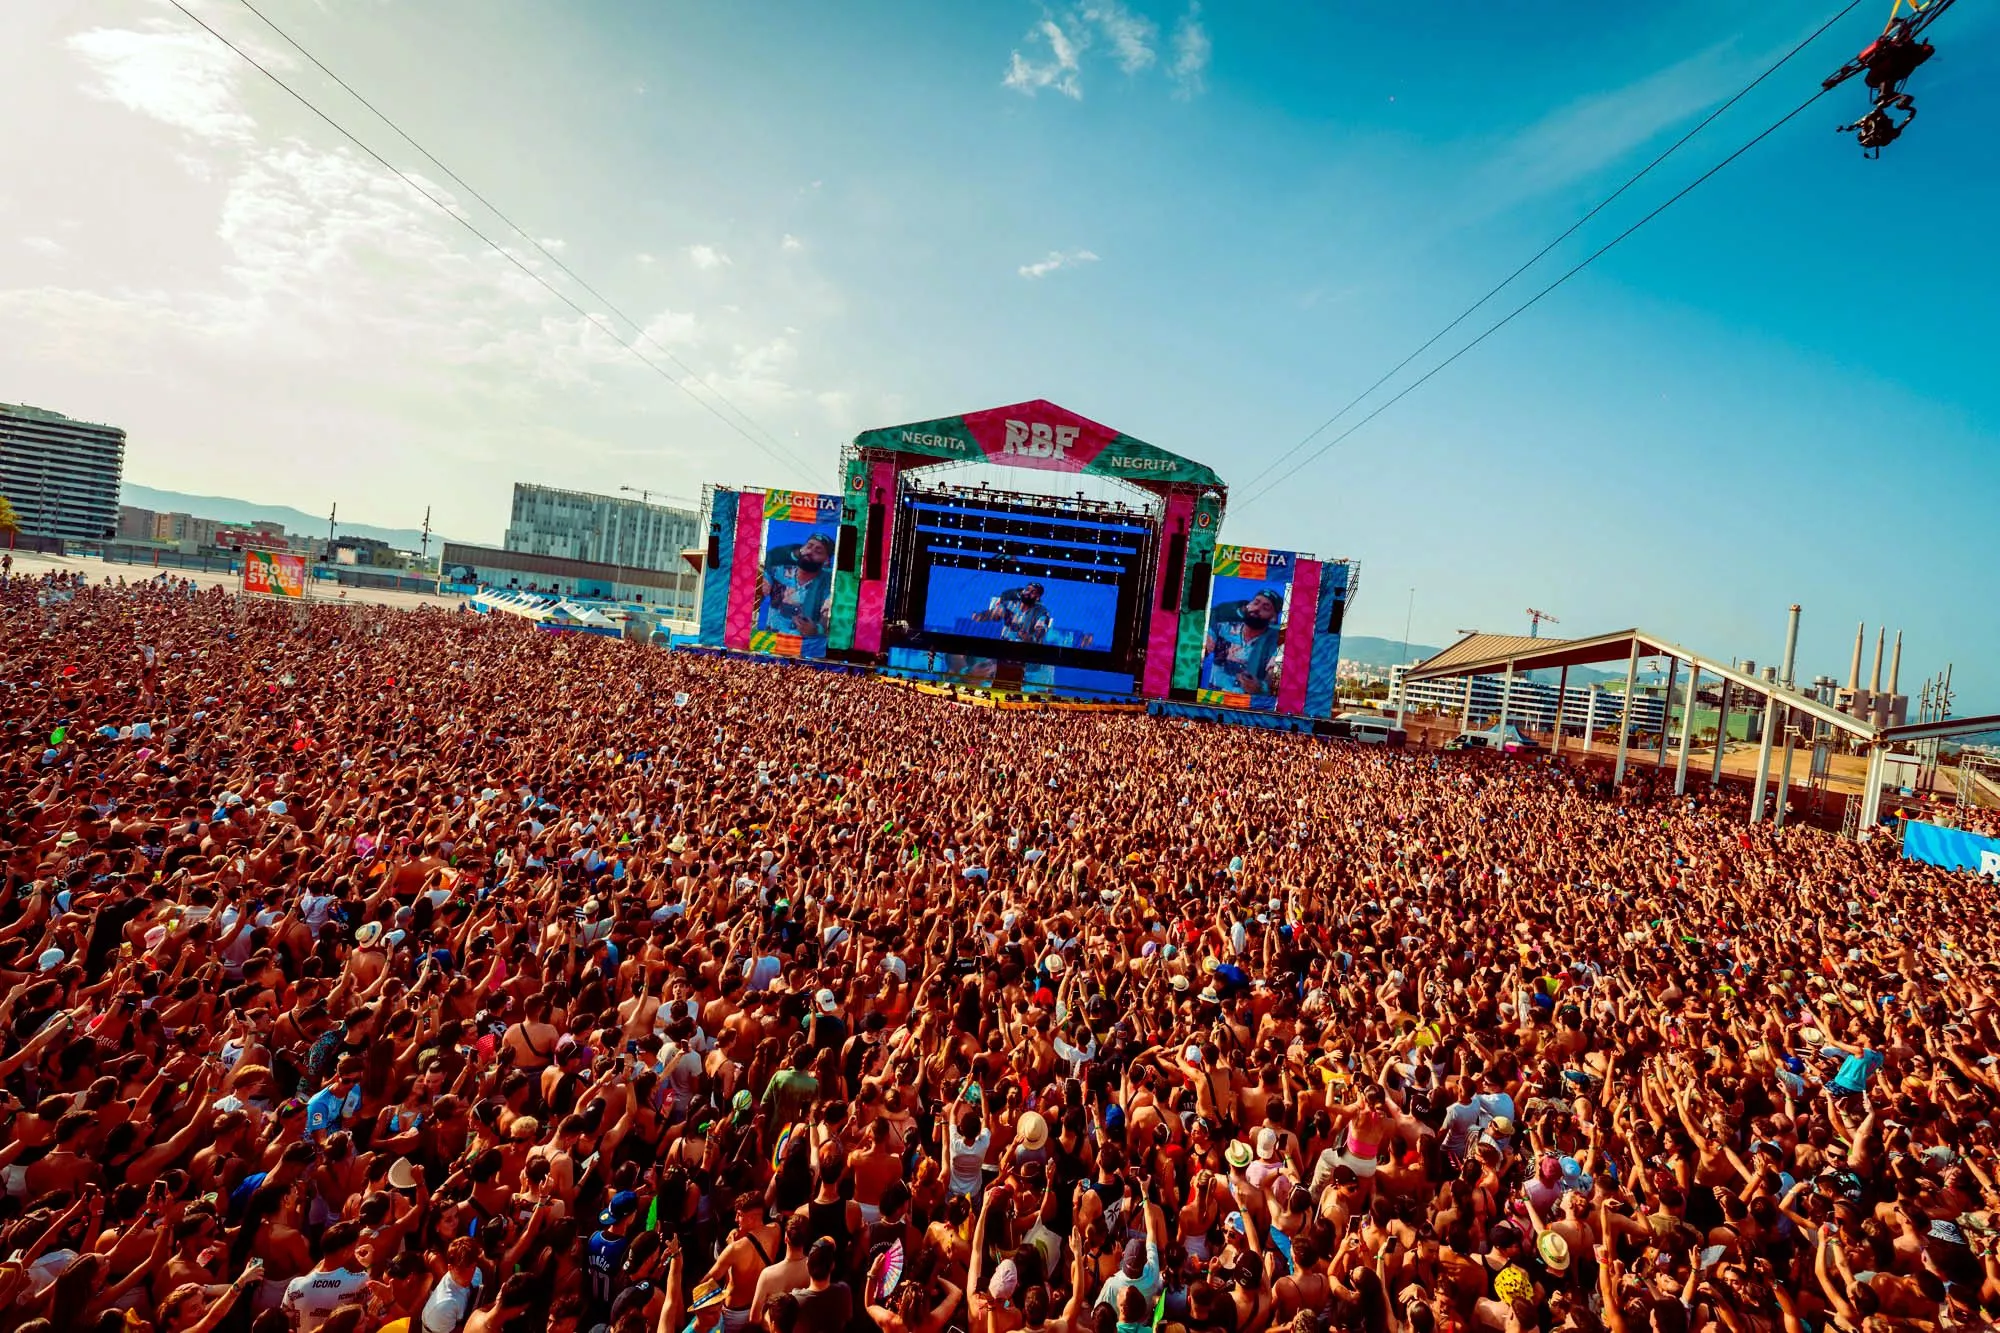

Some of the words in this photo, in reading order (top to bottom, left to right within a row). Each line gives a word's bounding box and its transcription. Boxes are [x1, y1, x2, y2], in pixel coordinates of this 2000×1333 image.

[901, 430, 967, 451] NEGRITA
[1003, 419, 1081, 460] RBF
[1110, 455, 1178, 472] NEGRITA
[773, 492, 836, 510] NEGRITA
[1222, 548, 1287, 566] NEGRITA
[249, 560, 300, 576] FRONT
[247, 572, 299, 589] STAGE
[312, 1280, 341, 1288] ICONO
